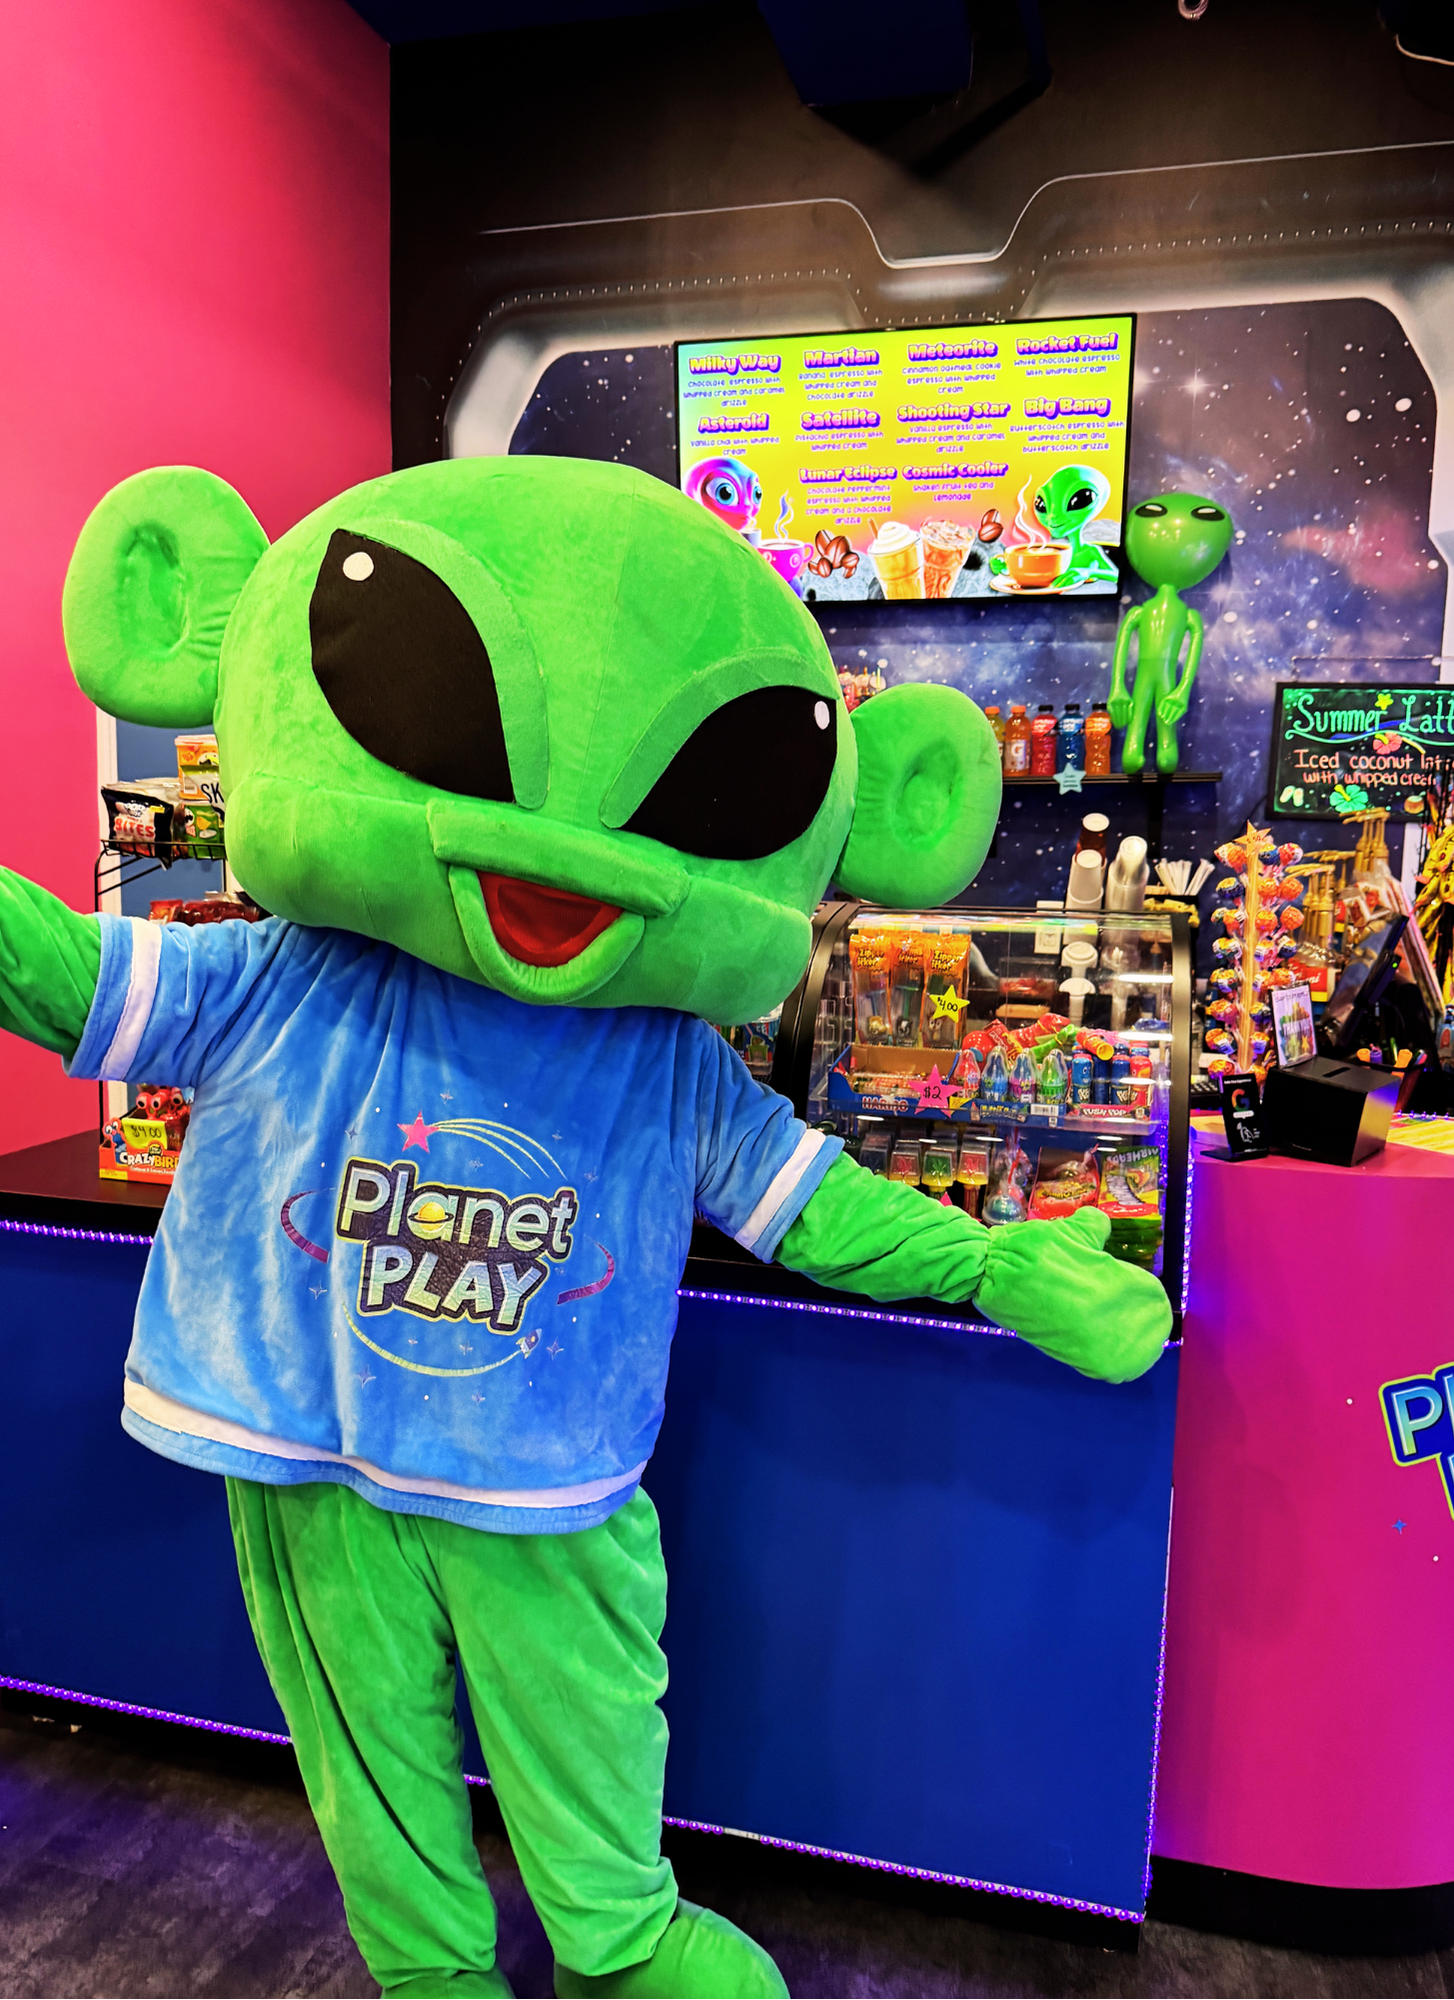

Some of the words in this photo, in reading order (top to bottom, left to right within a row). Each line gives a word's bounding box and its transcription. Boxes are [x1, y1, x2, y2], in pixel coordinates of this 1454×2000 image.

[908, 339, 998, 361] Meteorite
[1017, 336, 1078, 355] Rocket
[1078, 333, 1118, 351] Fuel
[689, 355, 738, 375] Milky
[738, 354, 781, 373] Way
[804, 347, 879, 368] Martian
[897, 403, 973, 422] Shooting
[973, 402, 1011, 418] Star
[1024, 397, 1059, 419] Big
[1059, 397, 1111, 418] Bang
[698, 413, 769, 433] Asteroid
[801, 408, 881, 430] Satellite
[800, 468, 843, 483] Lunar
[842, 464, 898, 483] Eclipse
[902, 463, 958, 480] Cosmic
[957, 461, 1009, 478] Cooler
[1293, 694, 1388, 732] Summer
[1011, 742, 1025, 757] G
[1293, 749, 1340, 768] Iced
[1349, 754, 1414, 770] coconut
[1302, 771, 1338, 785] with
[1344, 771, 1397, 788] whipped
[114, 818, 155, 838] BITES
[937, 997, 958, 1012] $4.00
[922, 1086, 942, 1100] $2
[1231, 1088, 1250, 1112] G
[1083, 1107, 1108, 1116] PUSH
[1108, 1108, 1127, 1117] POP
[340, 1165, 575, 1253] Planet
[366, 1244, 543, 1326] PLAY
